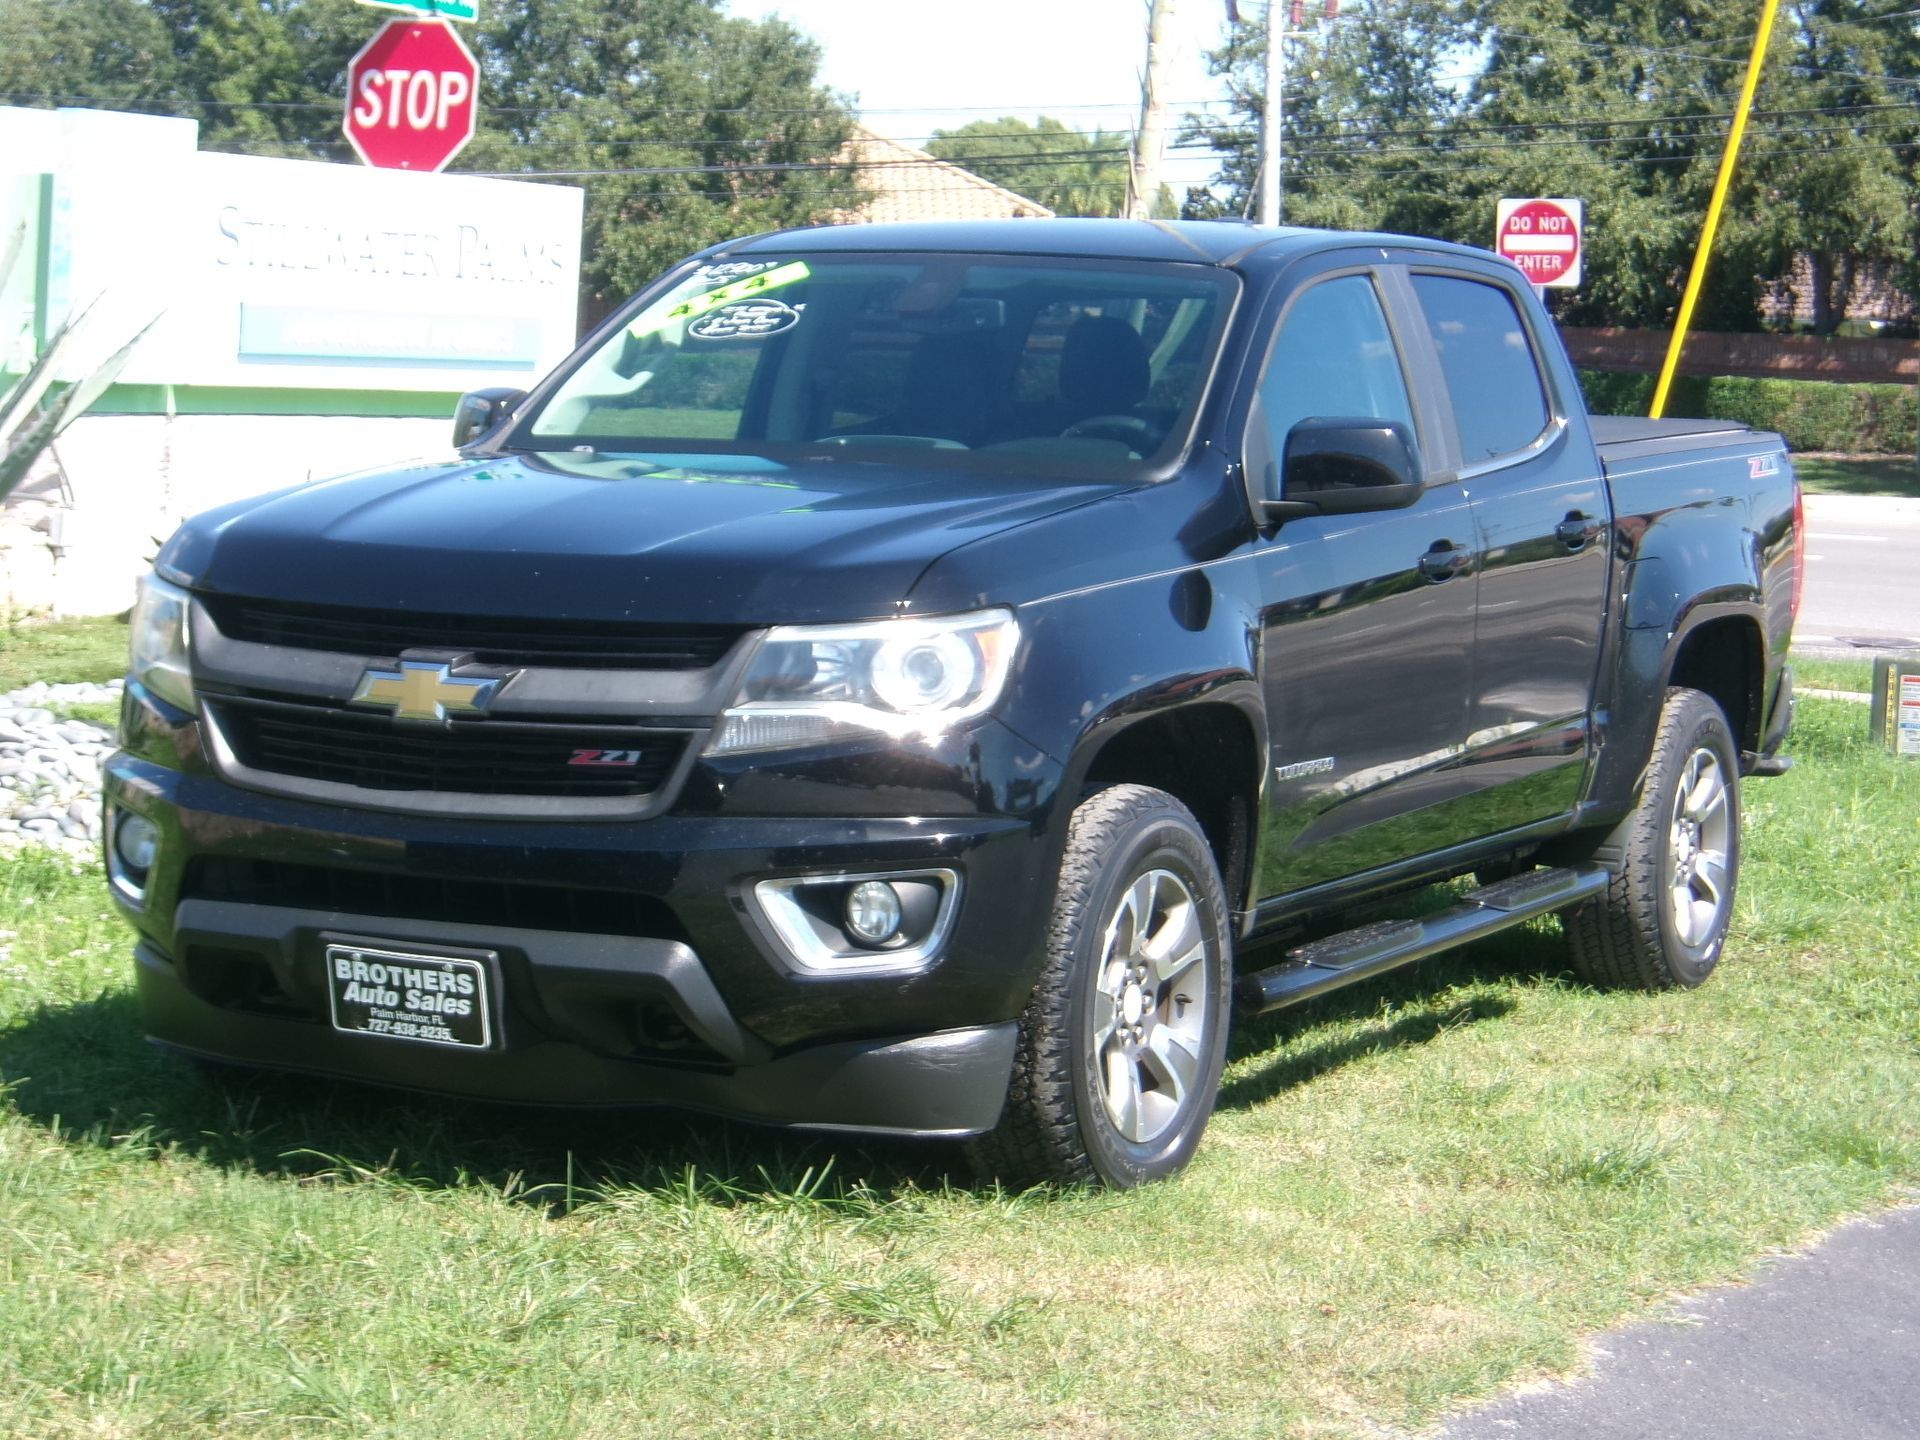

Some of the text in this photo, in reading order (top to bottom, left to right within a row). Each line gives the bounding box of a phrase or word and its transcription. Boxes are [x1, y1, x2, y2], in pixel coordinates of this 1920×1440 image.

[354, 68, 469, 130] STOP
[1510, 216, 1568, 232] DO NOT
[1514, 254, 1562, 270] ENTER
[567, 750, 641, 766] Z71
[335, 959, 474, 994] BROTHERS
[343, 981, 472, 1015] Auto Sales
[370, 1007, 394, 1018] Palm
[432, 1014, 446, 1025] FL
